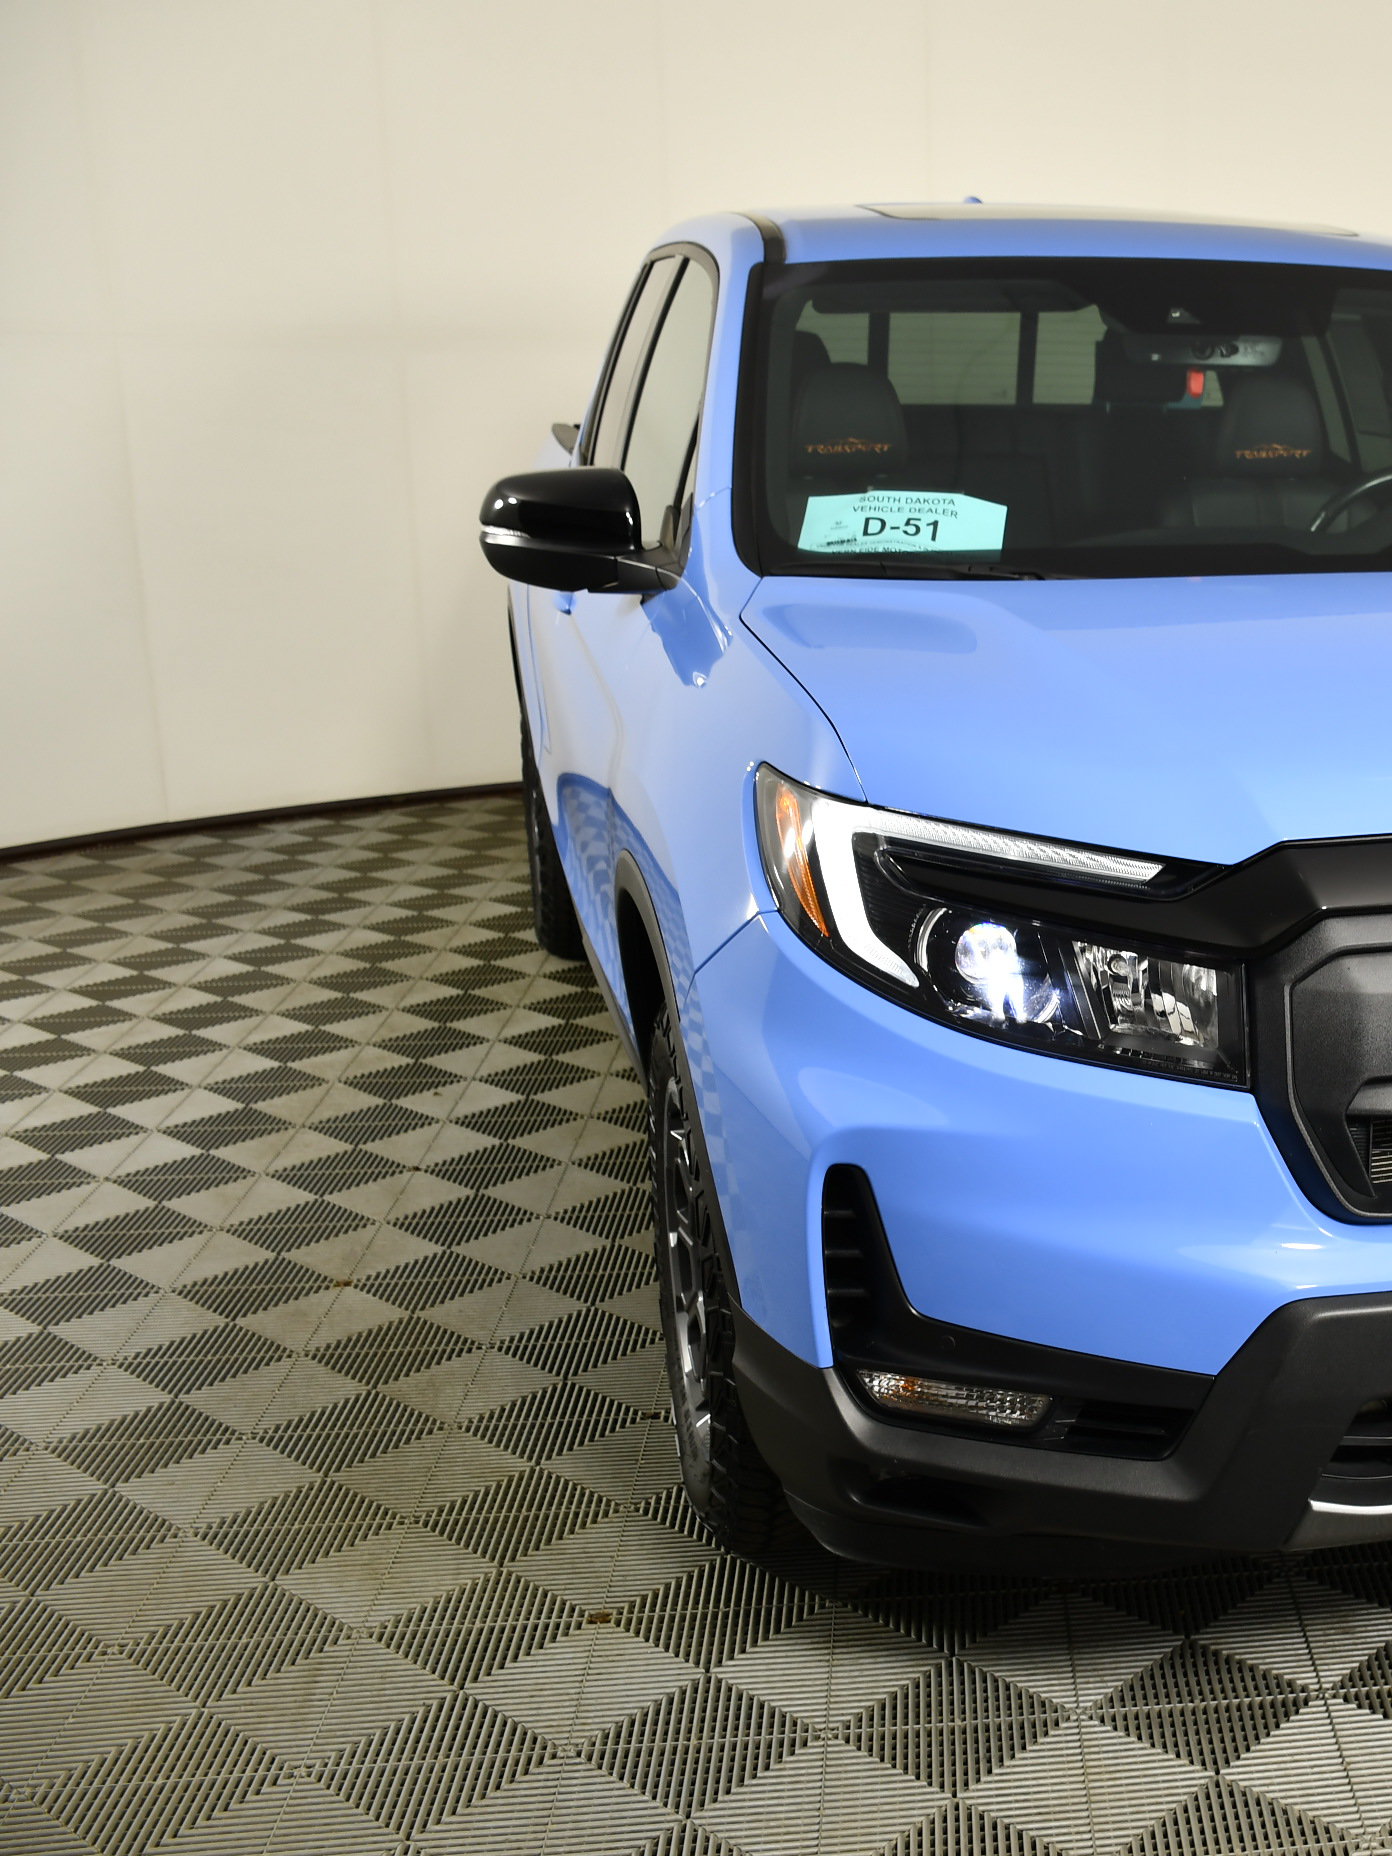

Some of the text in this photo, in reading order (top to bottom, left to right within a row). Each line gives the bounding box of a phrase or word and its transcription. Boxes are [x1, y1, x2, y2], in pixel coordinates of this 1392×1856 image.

[859, 495, 956, 507] SOUTH DAKOTA
[853, 505, 958, 519] VEHICLE DEALER
[862, 516, 940, 542] D-51
